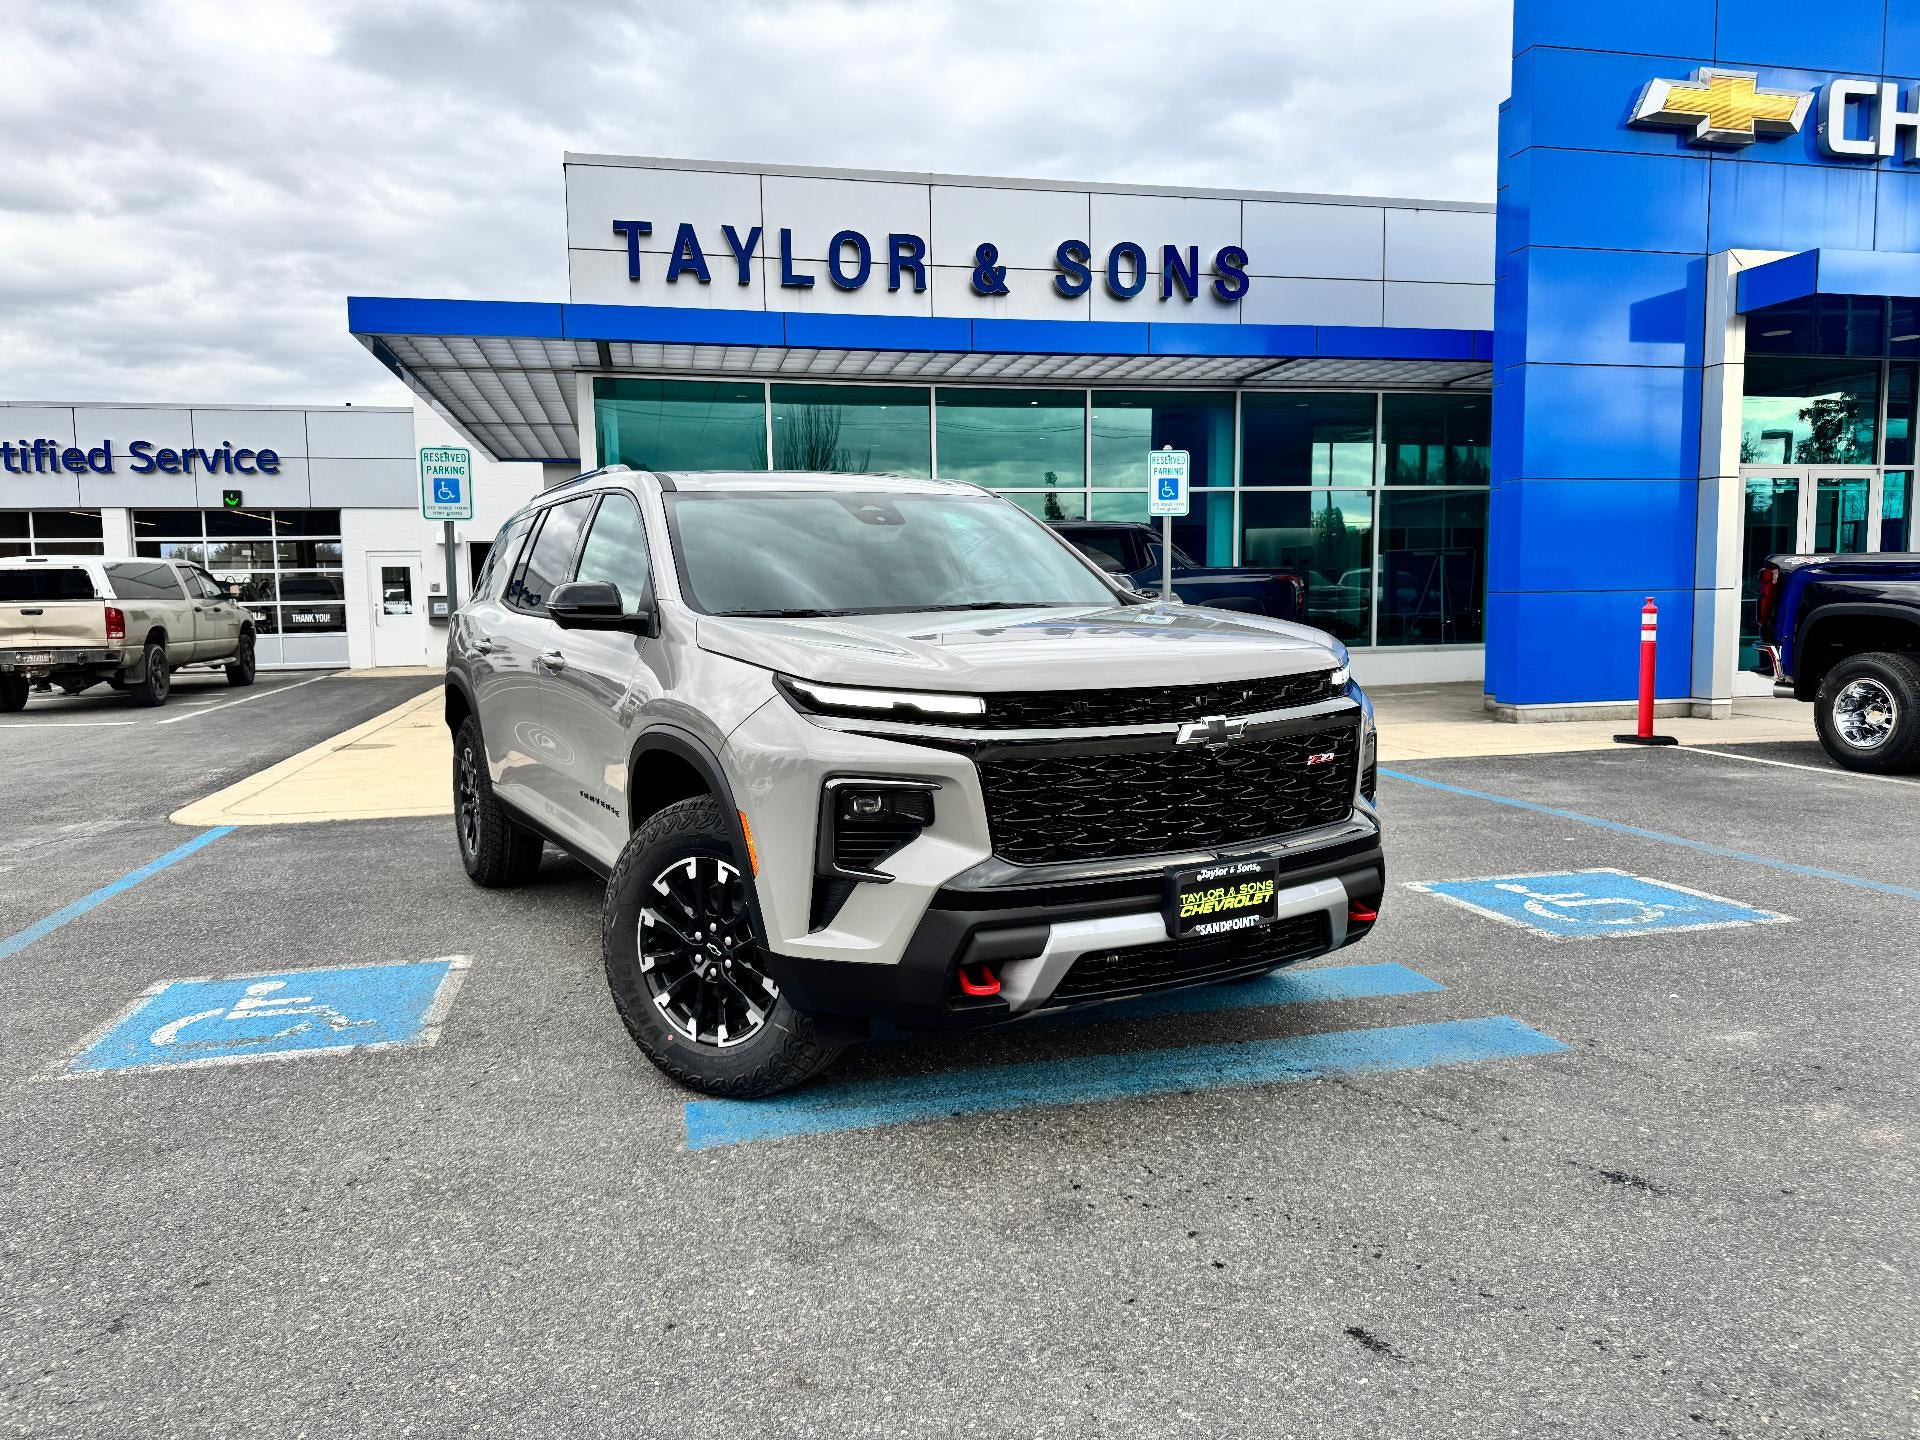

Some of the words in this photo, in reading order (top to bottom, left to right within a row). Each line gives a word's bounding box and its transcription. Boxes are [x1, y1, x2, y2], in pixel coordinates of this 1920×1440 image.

[612, 219, 928, 293] TAYLOR
[970, 242, 1010, 297] &
[1054, 239, 1251, 301] SONS
[0, 438, 115, 474] tified
[129, 440, 281, 475] Service
[423, 452, 467, 463] RESERVED
[1152, 456, 1186, 464] RESERVED
[426, 465, 465, 475] PARKING
[1154, 467, 1184, 475] PARKING
[292, 613, 314, 622] THANK
[315, 613, 331, 622] YOU!
[1200, 867, 1228, 880] Taylor
[1237, 863, 1258, 874] Sons
[1180, 888, 1225, 905] TAYLOR
[1228, 886, 1236, 898] &
[1239, 880, 1274, 893] SONS
[1180, 890, 1274, 918] CHEVROLET
[1200, 915, 1257, 936] SANDPOINT
